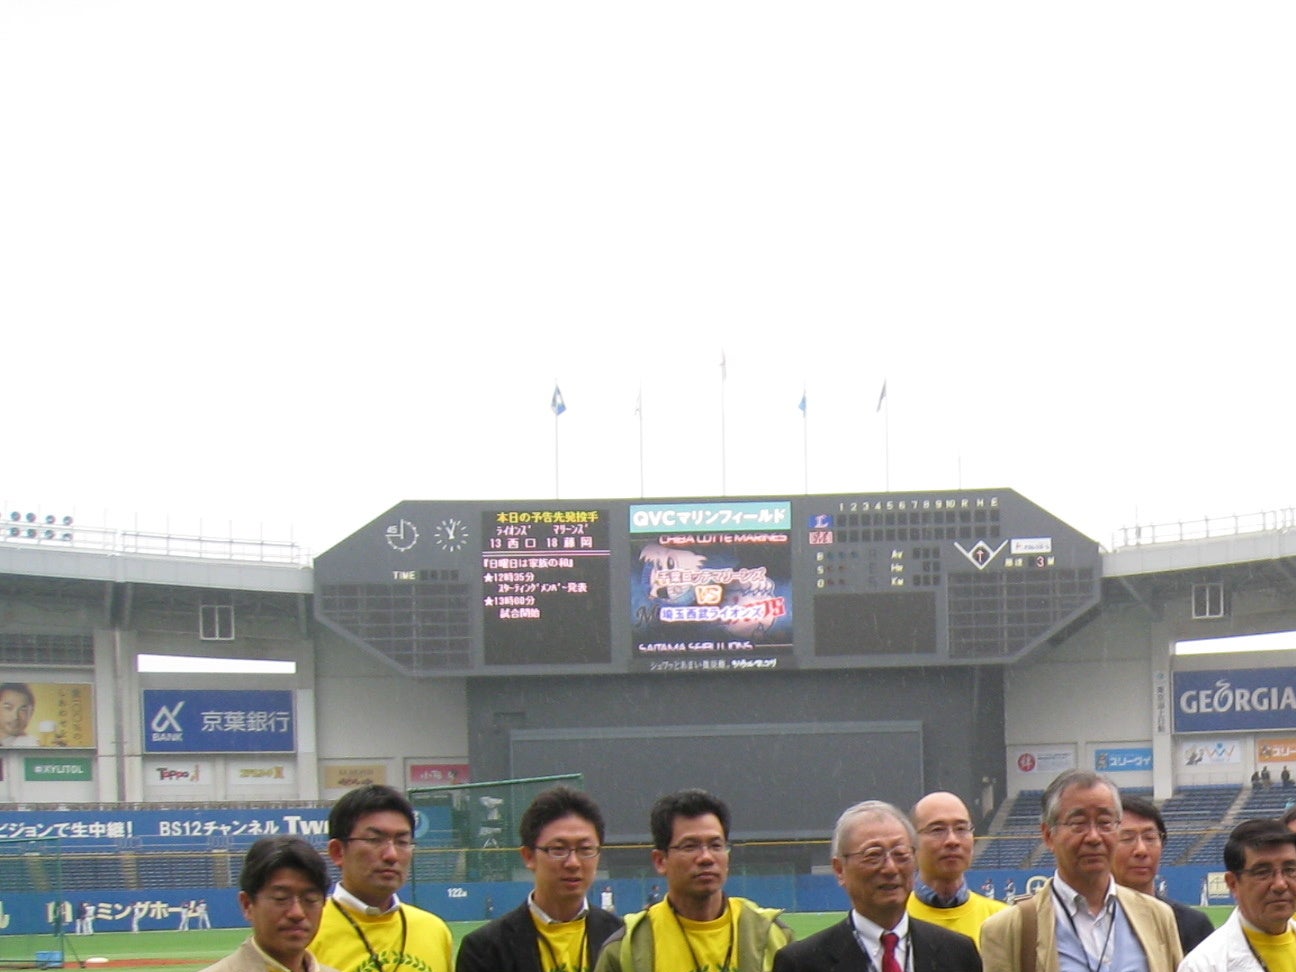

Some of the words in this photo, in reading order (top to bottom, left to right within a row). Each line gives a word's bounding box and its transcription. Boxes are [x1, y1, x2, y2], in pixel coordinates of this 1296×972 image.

[632, 508, 787, 527] QVCマリンフィールド
[201, 711, 290, 732] 京葉銀行
[152, 733, 183, 742] BANK
[159, 820, 279, 837] BS12チャンネル
